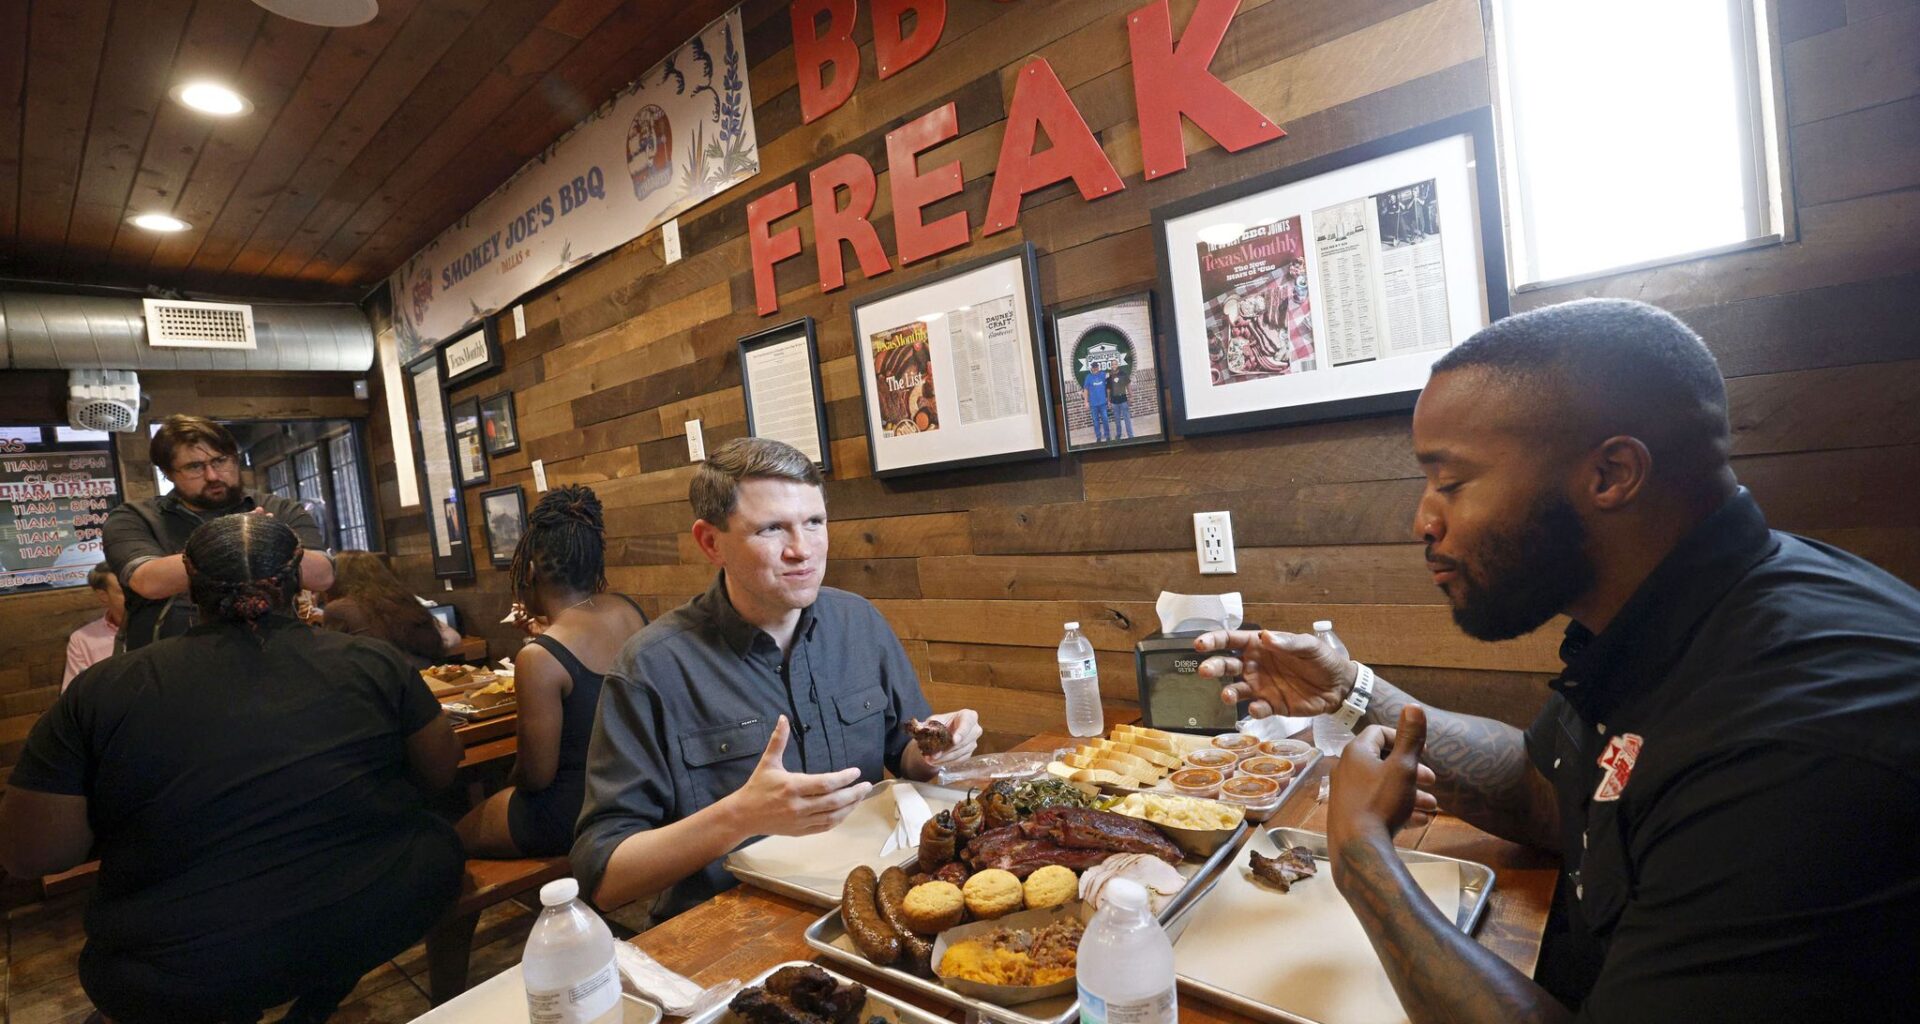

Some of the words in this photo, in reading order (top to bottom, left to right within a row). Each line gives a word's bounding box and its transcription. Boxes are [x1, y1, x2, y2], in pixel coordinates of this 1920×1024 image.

[791, 0, 948, 126] BB
[746, 0, 1288, 317] FREAK
[442, 232, 501, 290] SMOKEY
[506, 196, 554, 249] JOE'S
[559, 166, 605, 216] BBQ
[1268, 220, 1291, 235] JOINTS
[502, 251, 523, 274] DALLAS
[1233, 265, 1248, 273] The
[1249, 260, 1266, 269] New
[1248, 268, 1257, 276] of
[886, 375, 905, 392] The
[4, 459, 48, 472] 11AM
[24, 471, 92, 485] CLOSED
[12, 501, 57, 516] 11AM
[70, 498, 107, 511] 8PM
[14, 515, 57, 530] 11AM
[16, 531, 61, 545] 11AM
[19, 543, 63, 559] 11AM
[77, 541, 103, 554] 9P
